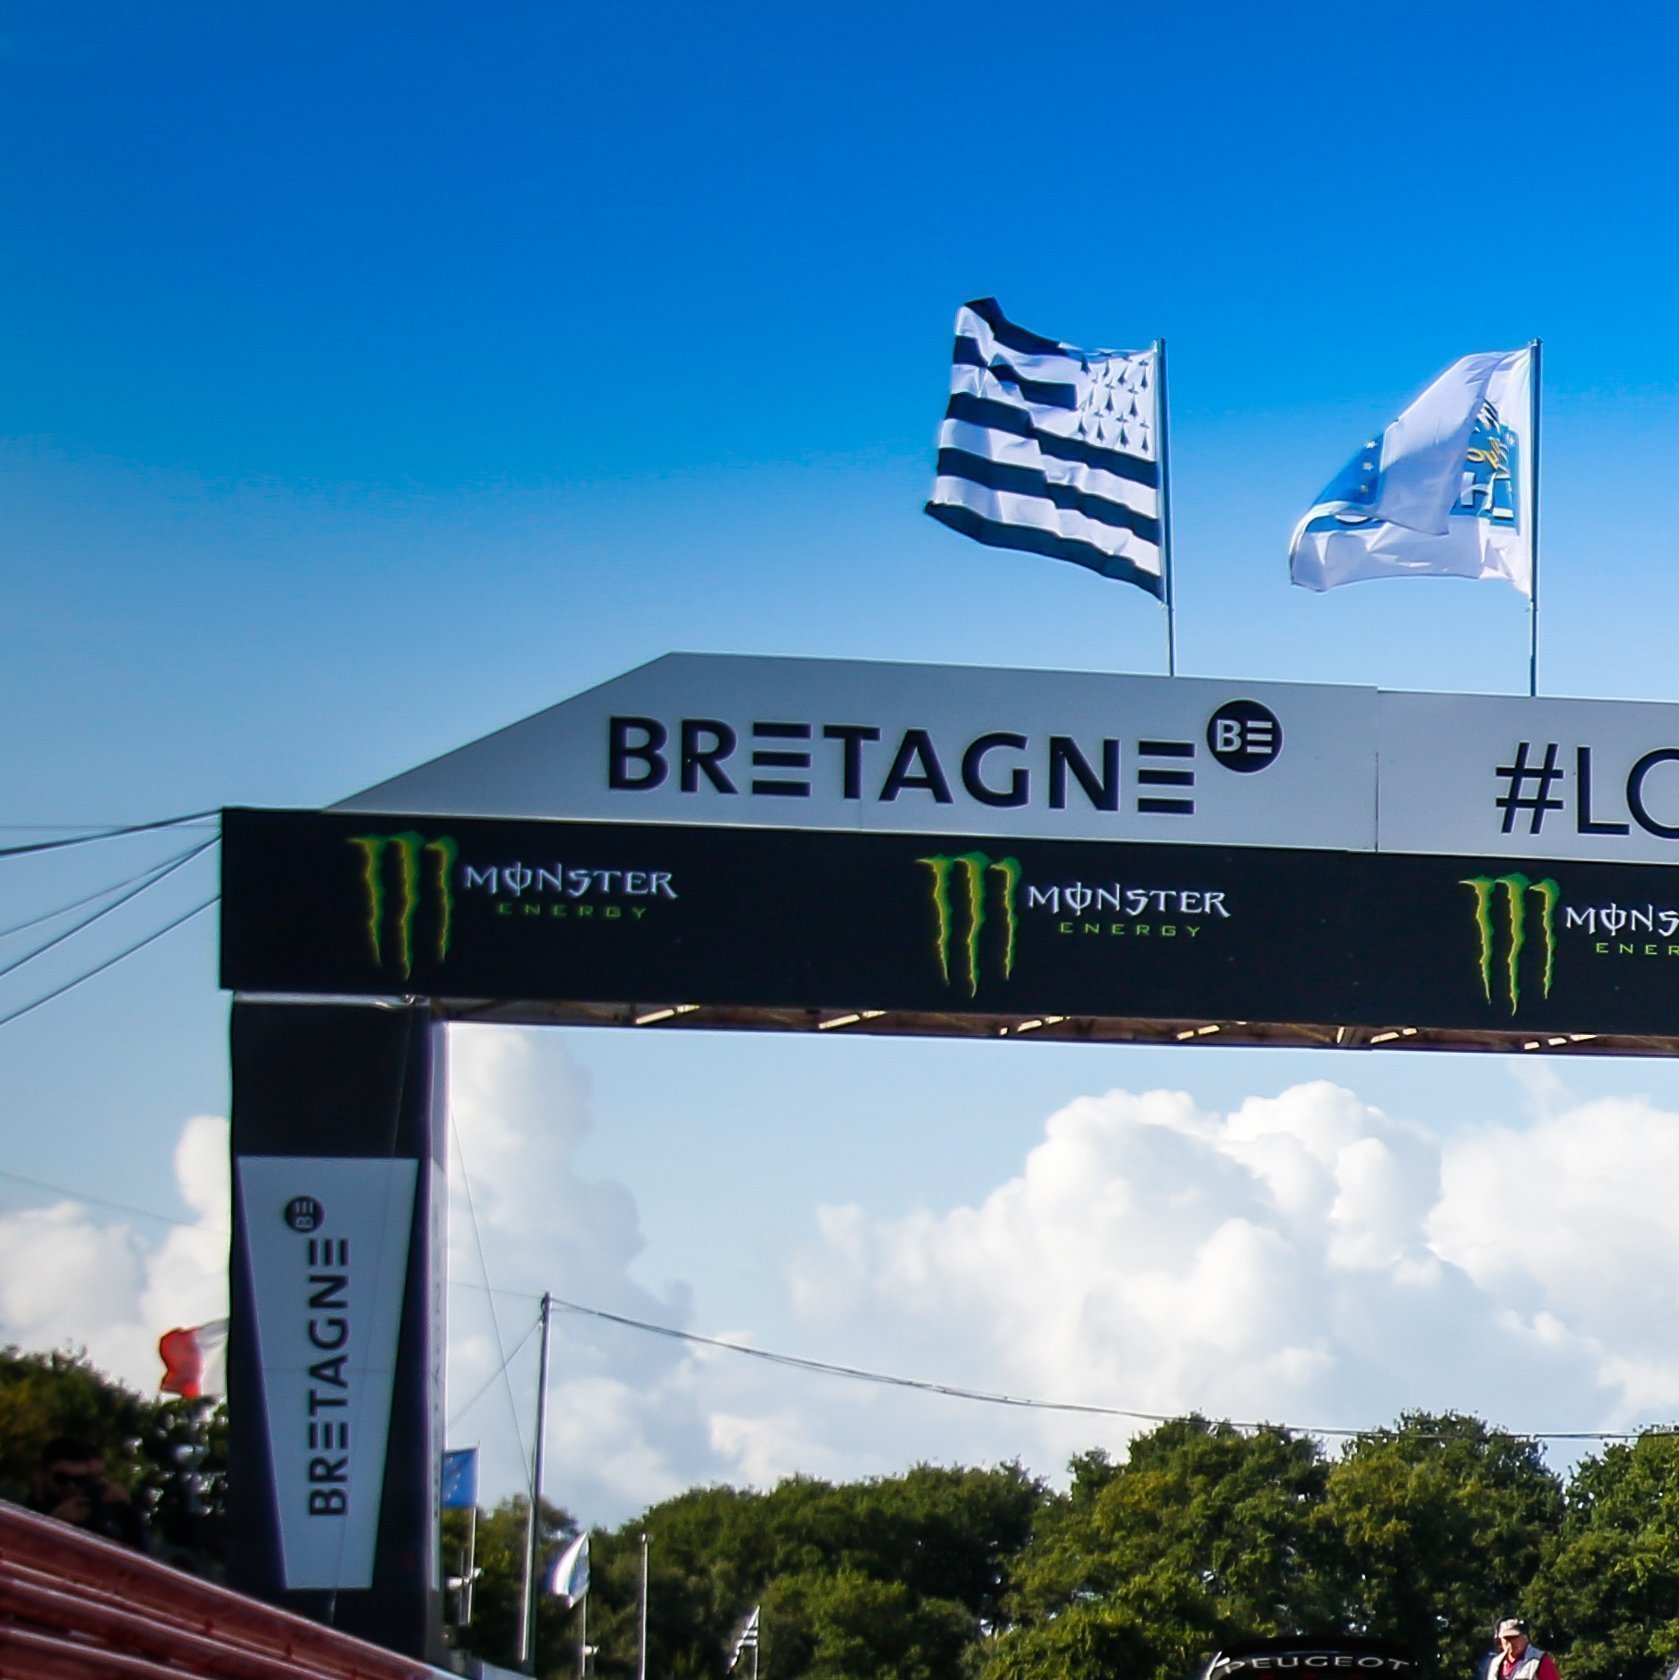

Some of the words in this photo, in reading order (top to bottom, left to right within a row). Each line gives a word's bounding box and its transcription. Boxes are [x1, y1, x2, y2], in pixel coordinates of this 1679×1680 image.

[608, 715, 1194, 816] BRETAGNE
[465, 861, 678, 900] MONSTER
[497, 903, 647, 920] ENERGY
[1028, 883, 1231, 919] MONSTER
[1060, 922, 1200, 937] ENERGY
[309, 1239, 348, 1516] BRETAGNE
[1226, 1656, 1408, 1674] PEUGEOT
